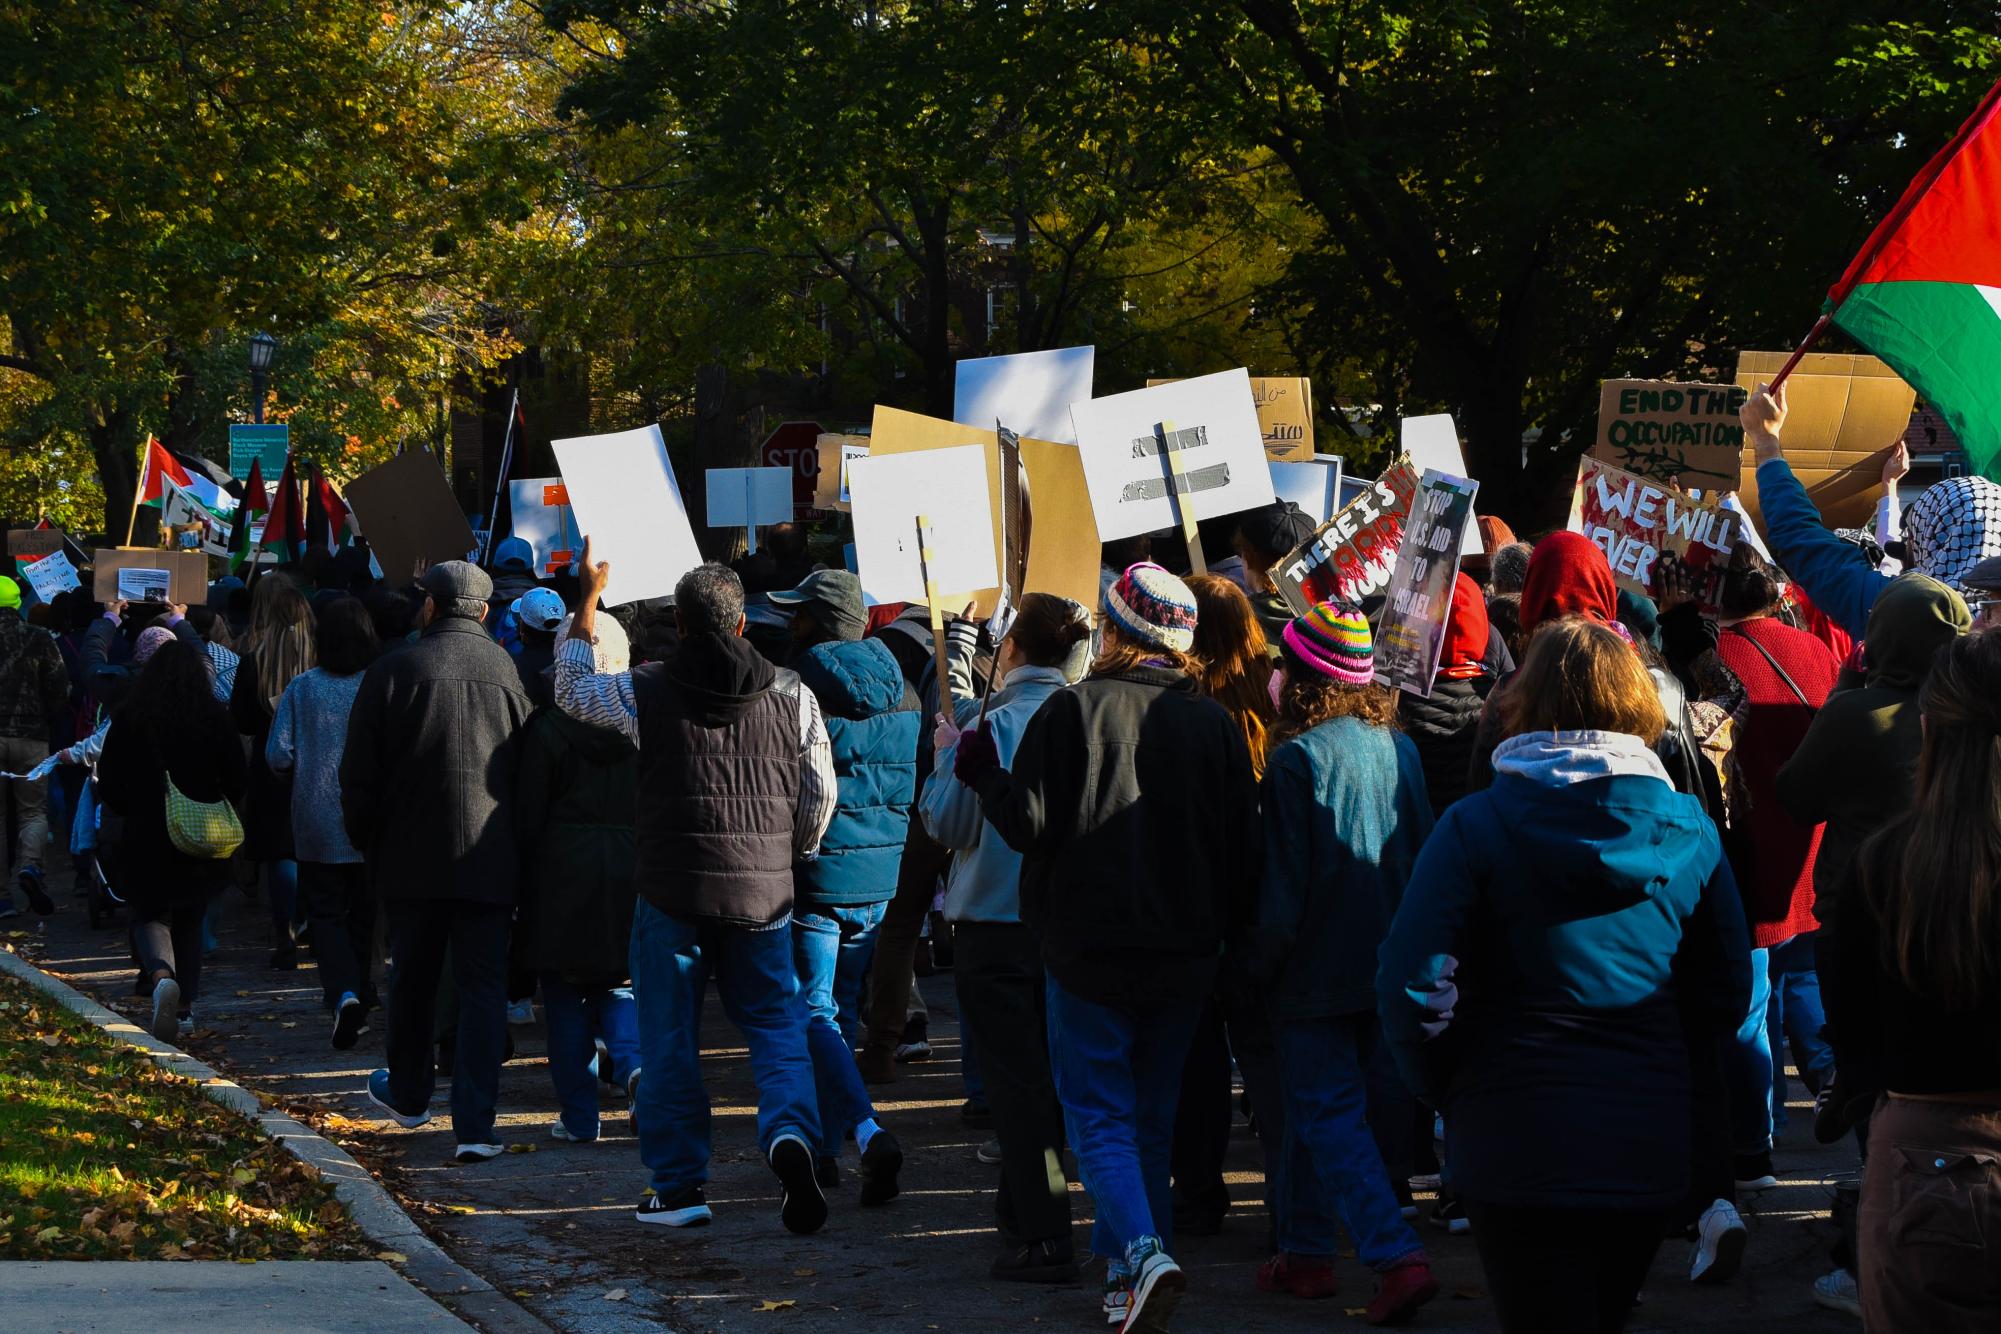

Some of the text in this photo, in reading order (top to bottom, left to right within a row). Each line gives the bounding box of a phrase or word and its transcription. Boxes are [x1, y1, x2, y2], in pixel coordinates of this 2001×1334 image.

[1619, 388, 1747, 416] END THE
[1608, 420, 1745, 448] OCCUPATION
[768, 448, 817, 478] STO
[1424, 488, 1453, 515] STOP
[1596, 474, 1732, 554] WE WILL
[1285, 481, 1395, 583] THERE IS
[1428, 525, 1451, 552] AID
[1583, 520, 1659, 586] EVER
[1411, 556, 1427, 583] TO
[1393, 588, 1430, 620] ISRAEL
